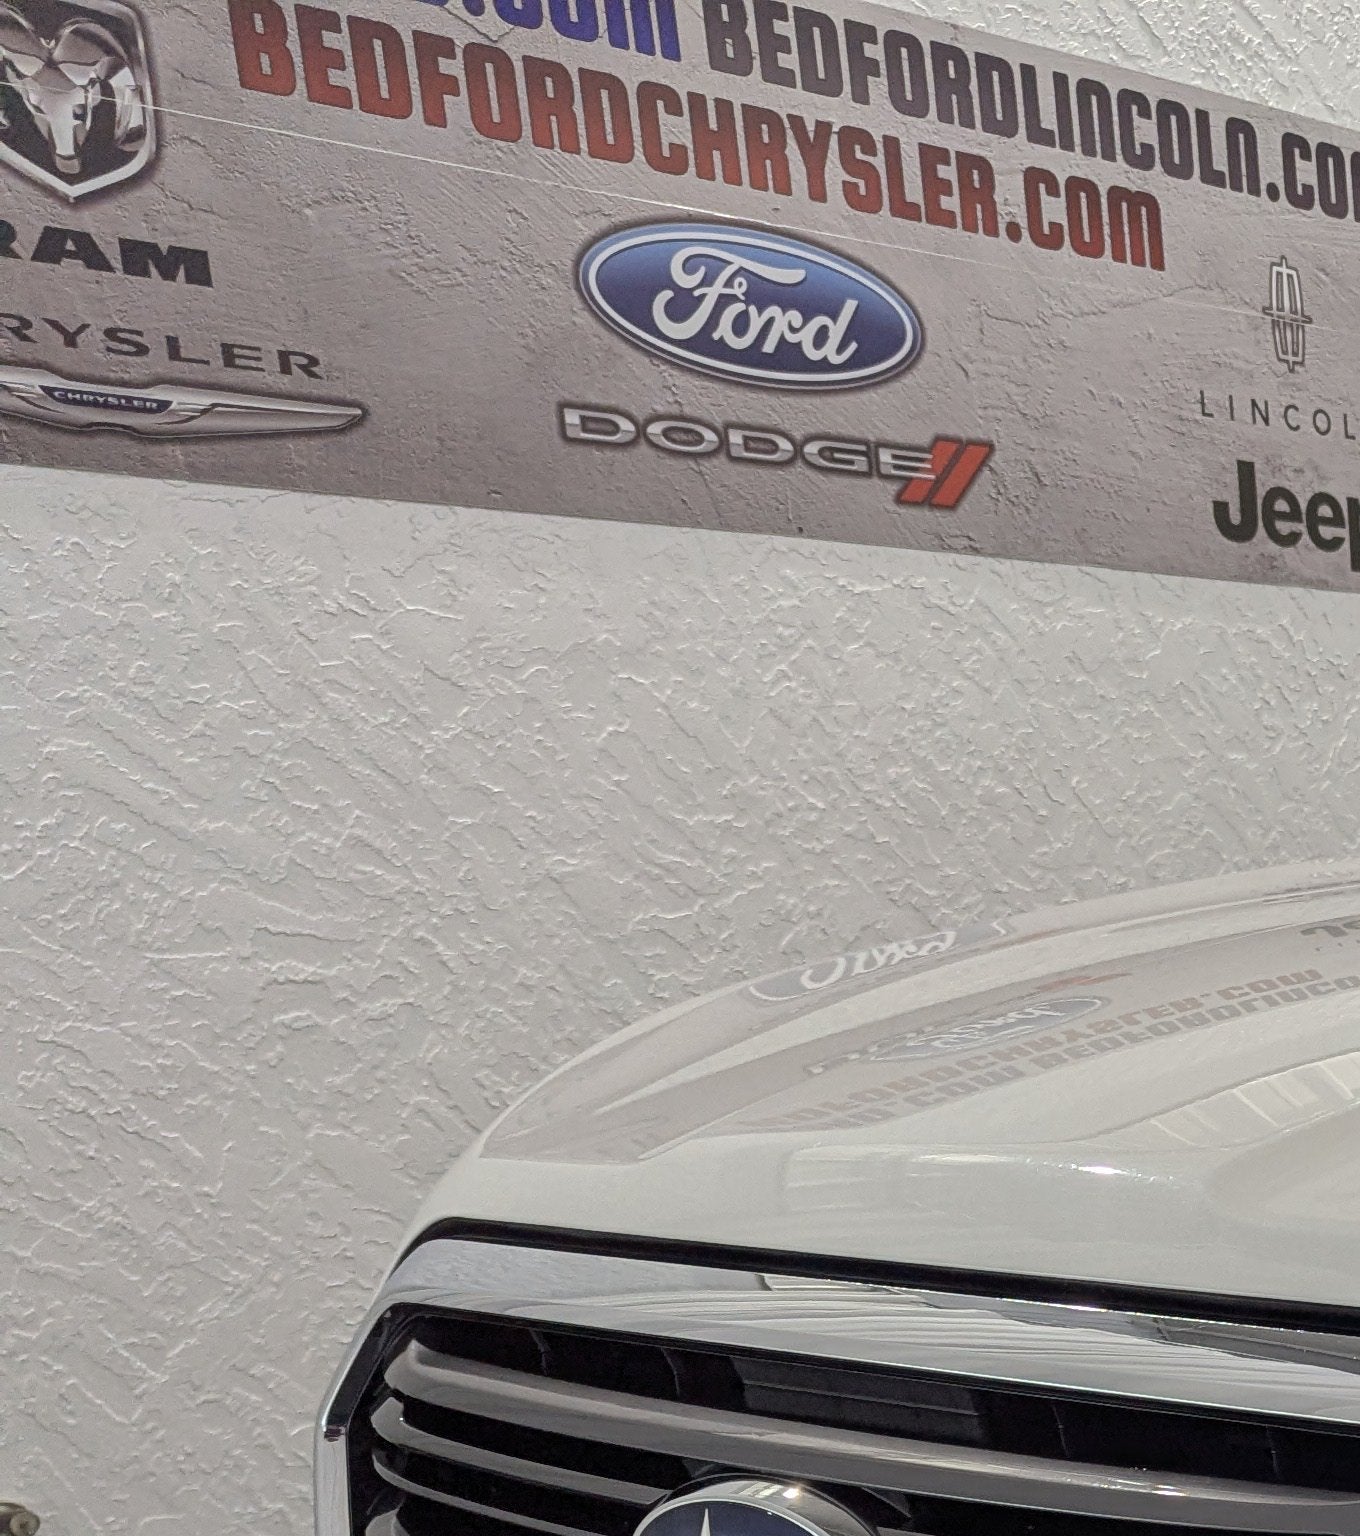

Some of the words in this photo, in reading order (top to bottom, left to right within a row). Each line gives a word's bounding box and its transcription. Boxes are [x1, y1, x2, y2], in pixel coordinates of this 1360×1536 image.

[229, 0, 1166, 271] BEDFORDCHRYSLER.COM
[652, 245, 857, 365] Ford
[53, 390, 158, 410] CHRYSLER
[562, 406, 936, 481] DODGE
